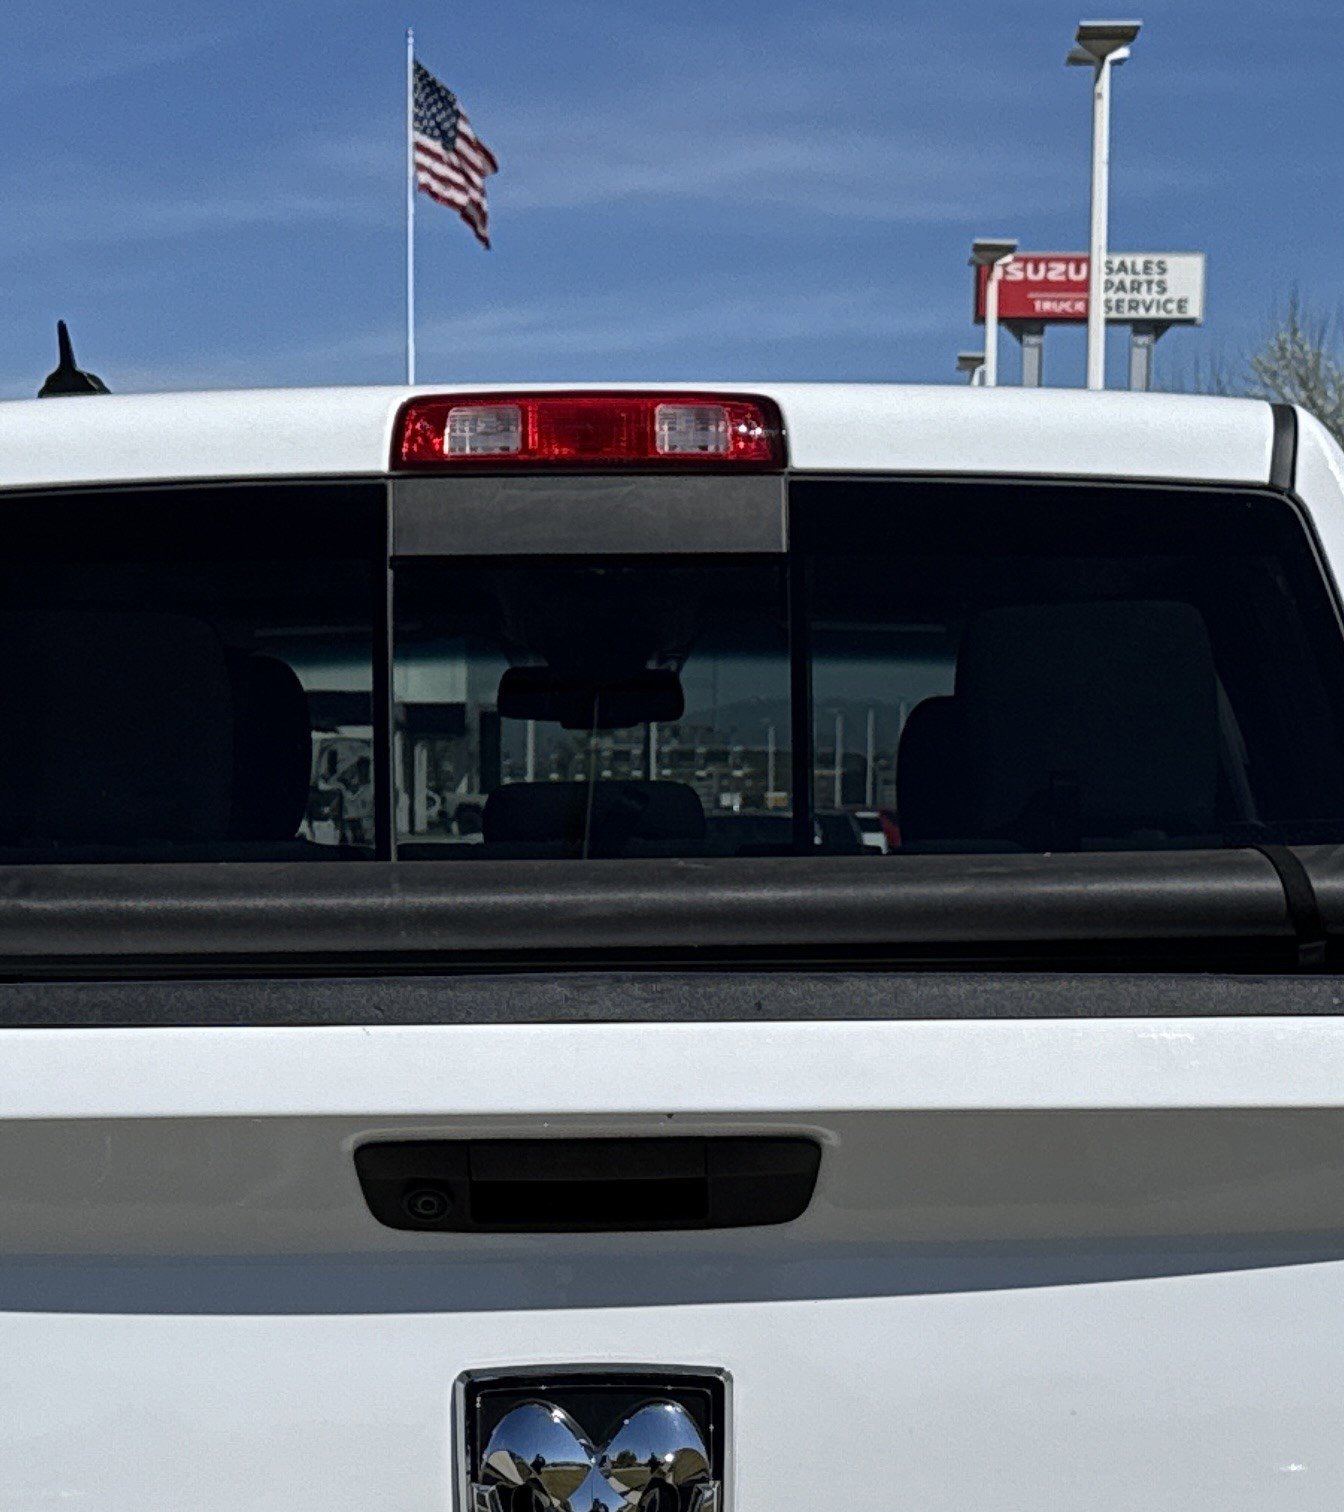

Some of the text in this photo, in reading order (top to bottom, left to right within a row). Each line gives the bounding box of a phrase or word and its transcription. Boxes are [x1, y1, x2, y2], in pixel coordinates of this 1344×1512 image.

[1104, 259, 1168, 276] SALES
[1103, 278, 1168, 295] PARTS
[1034, 299, 1087, 313] TRUCK
[1103, 297, 1189, 315] SERVICE
